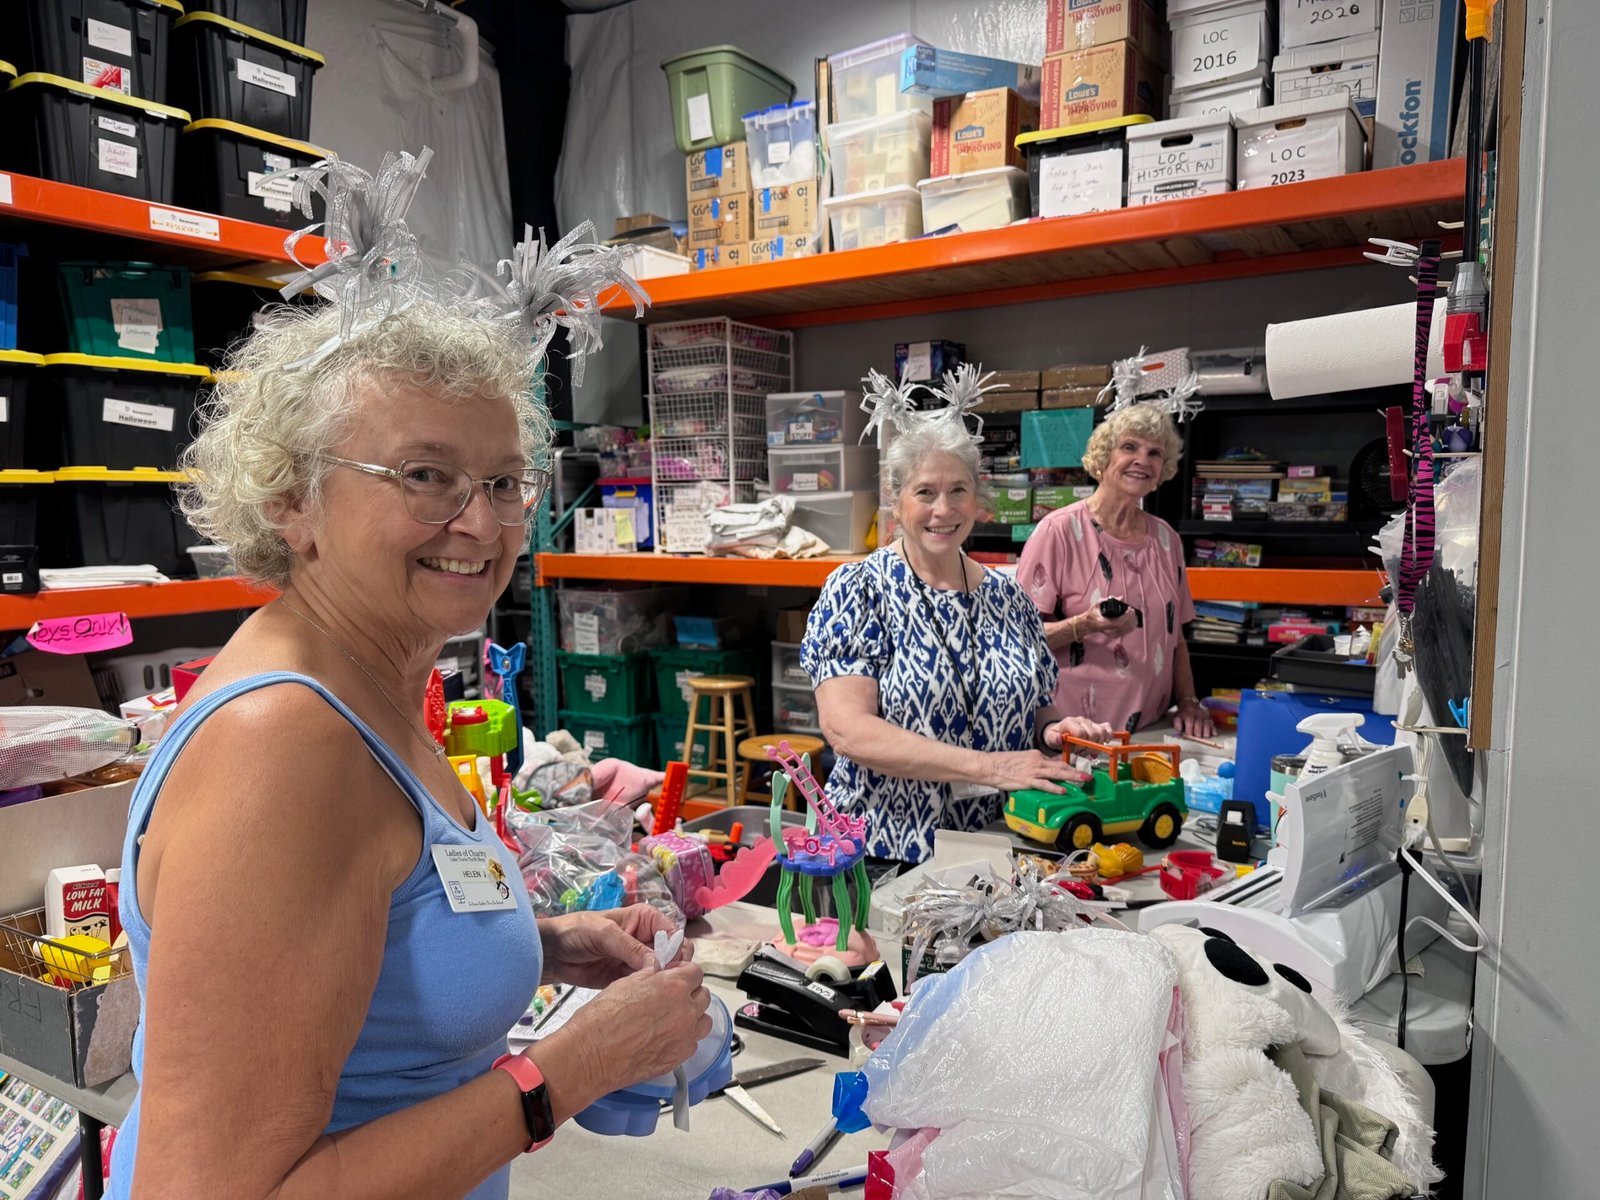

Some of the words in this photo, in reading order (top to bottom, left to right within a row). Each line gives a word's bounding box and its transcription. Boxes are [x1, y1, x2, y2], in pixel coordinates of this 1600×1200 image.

[1072, 4, 1122, 23] IMROVING
[1203, 29, 1229, 45] LOC
[1193, 50, 1237, 72] 2016
[252, 74, 285, 90] Halloween
[1068, 99, 1117, 116] IMPROVING
[1397, 79, 1422, 166] ockfon
[956, 141, 1002, 155] IMPROVING
[1157, 152, 1190, 165] LOC
[1271, 169, 1305, 186] 2023
[165, 221, 201, 234] RESERVED
[119, 414, 158, 426] Halloween
[74, 616, 118, 636] Only
[444, 849, 462, 857] Ladies
[469, 849, 487, 858] Charity
[66, 890, 87, 901] LOW
[89, 888, 106, 898] FAT
[71, 898, 102, 912] MILK
